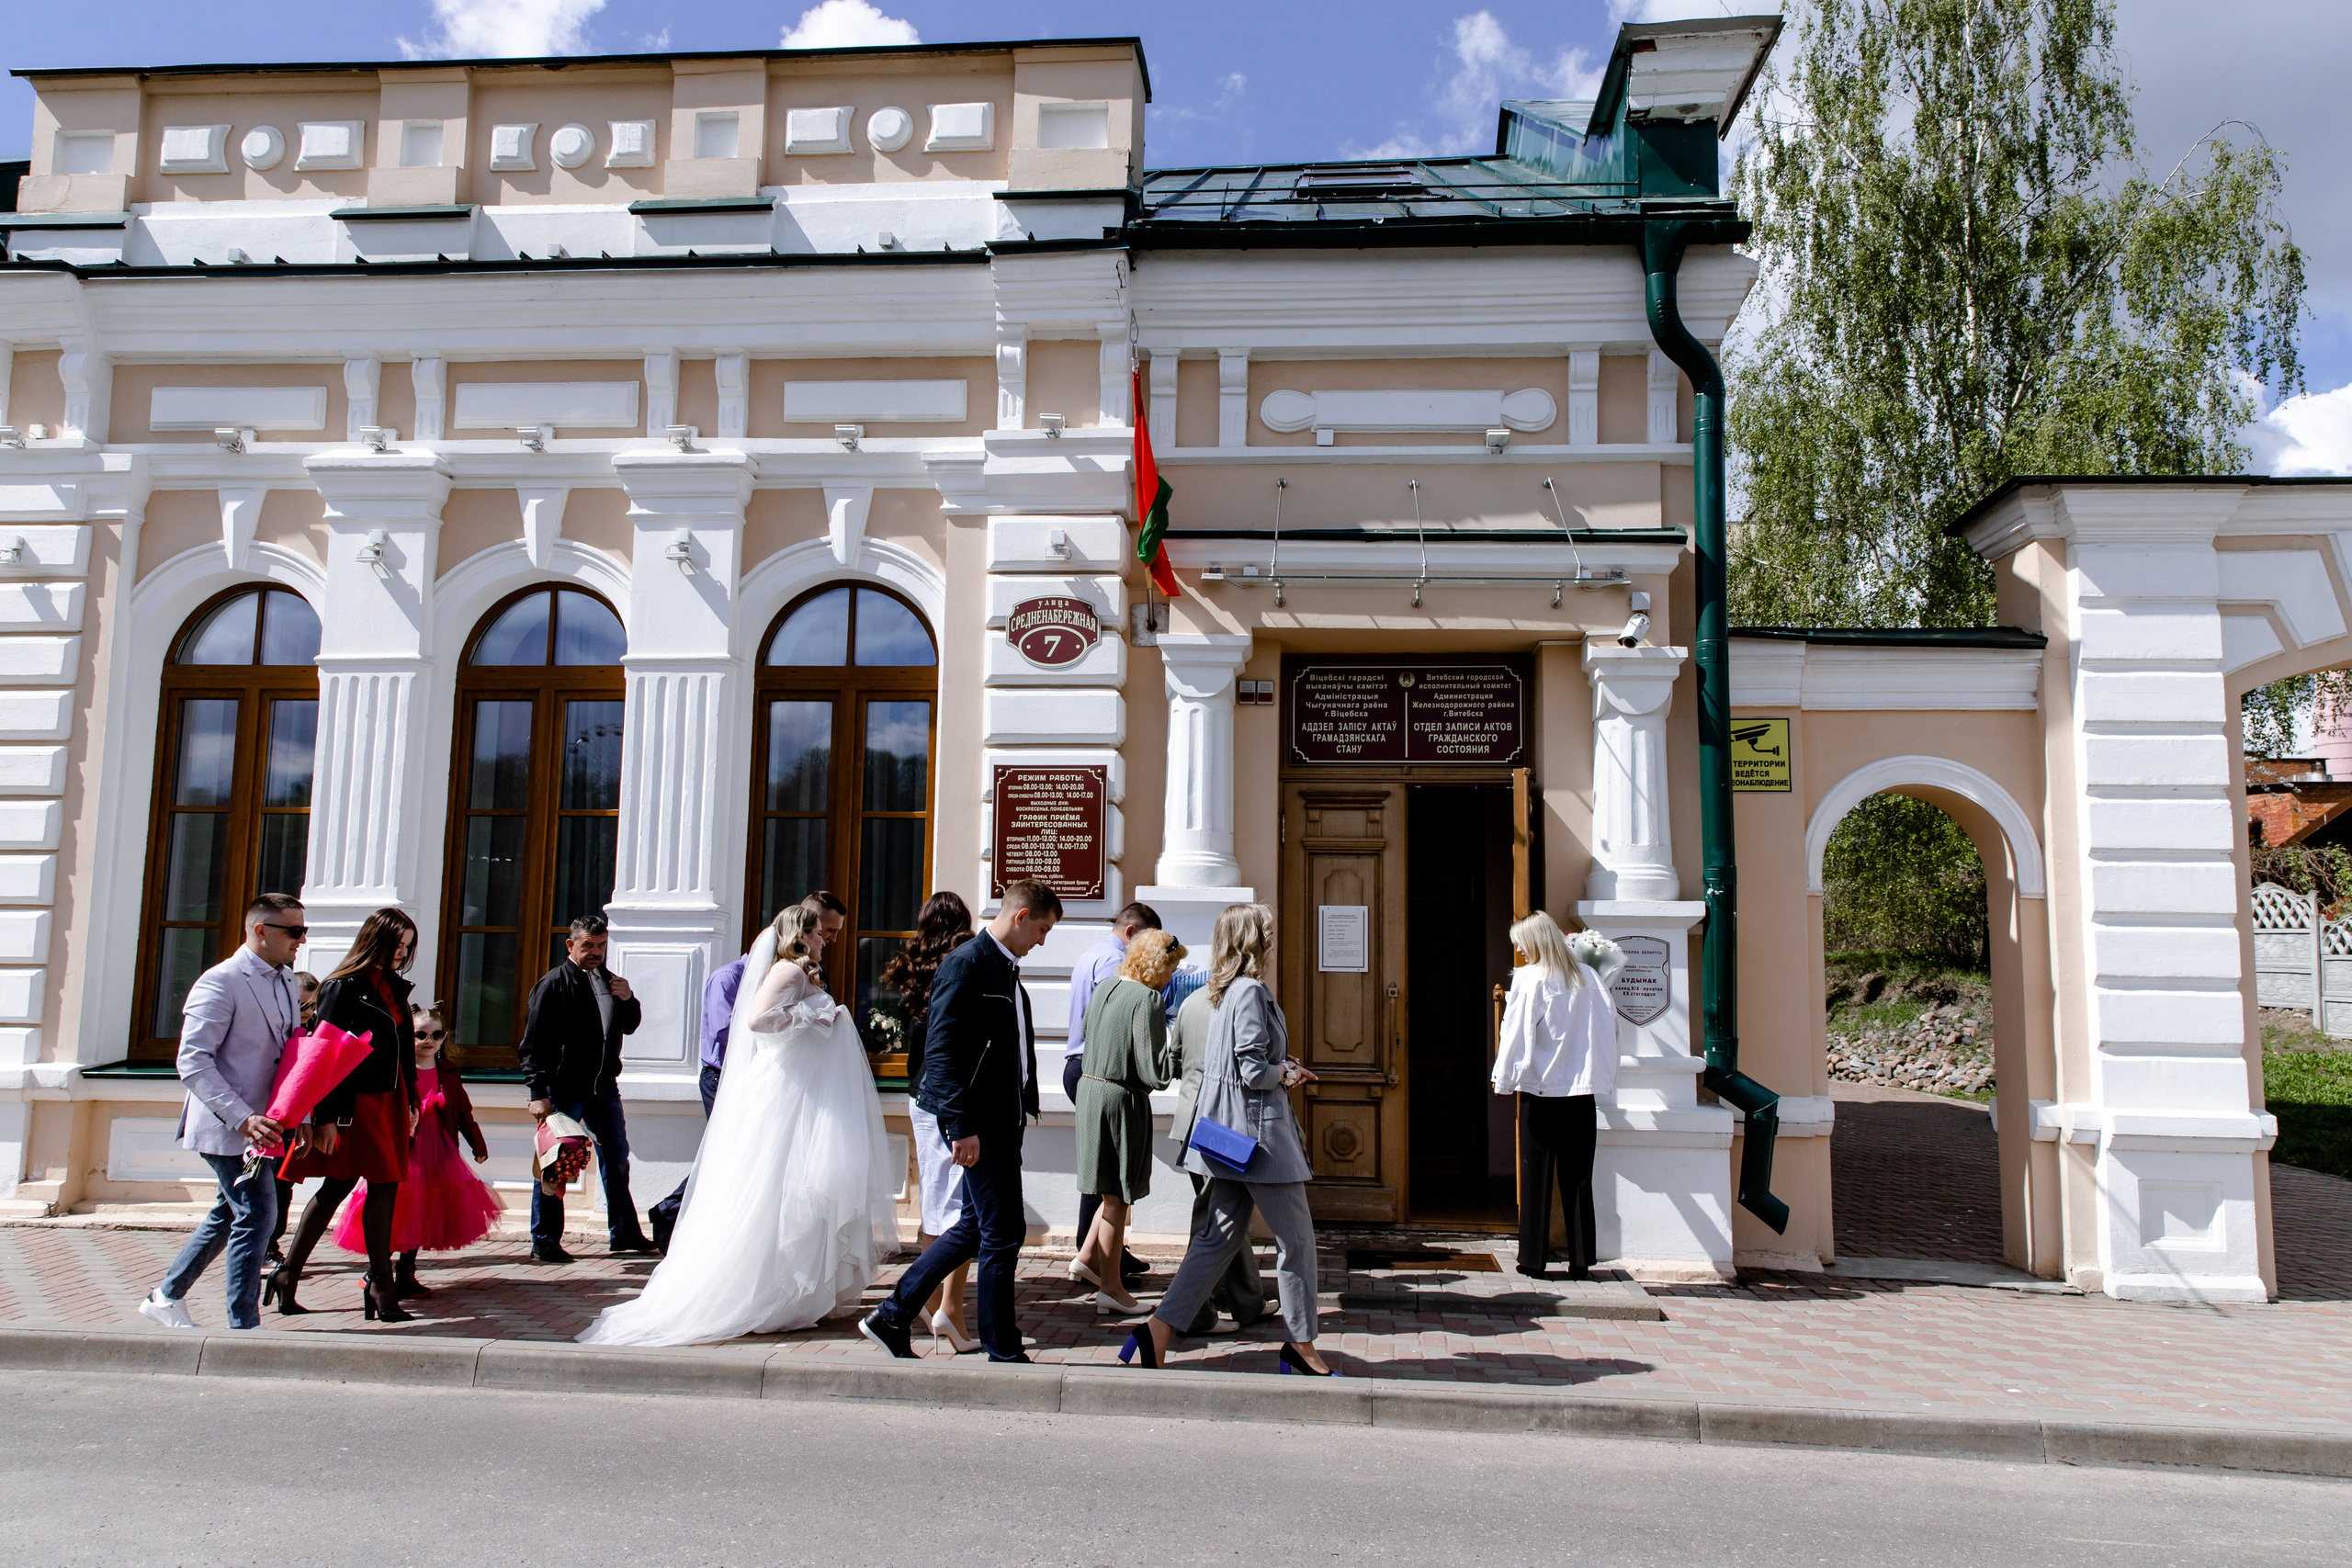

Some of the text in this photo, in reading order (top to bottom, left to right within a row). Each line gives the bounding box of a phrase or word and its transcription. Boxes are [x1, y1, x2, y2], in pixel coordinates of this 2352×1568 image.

[1038, 599, 1069, 608] улица
[1011, 609, 1096, 633] СРЕДНЕНАБЕРЕЖНАЯ
[1044, 635, 1061, 658] 7
[1488, 701, 1514, 709] района
[1302, 721, 1397, 732] АДДЗЕЛ ЗАПІСУ АКТАЎ
[1414, 723, 1512, 732] ОТДЕЛ ЗАПИСИ АКТОВ
[1312, 734, 1386, 743] ГРАМАДЗЯНСКАГА
[1428, 734, 1498, 743] ГРАЖДАНСКОГО
[1336, 745, 1363, 753] СТАНУ
[1437, 745, 1489, 753] СОСТОЯНИЯ
[1736, 769, 1770, 778] ВЕДЁТСЯ
